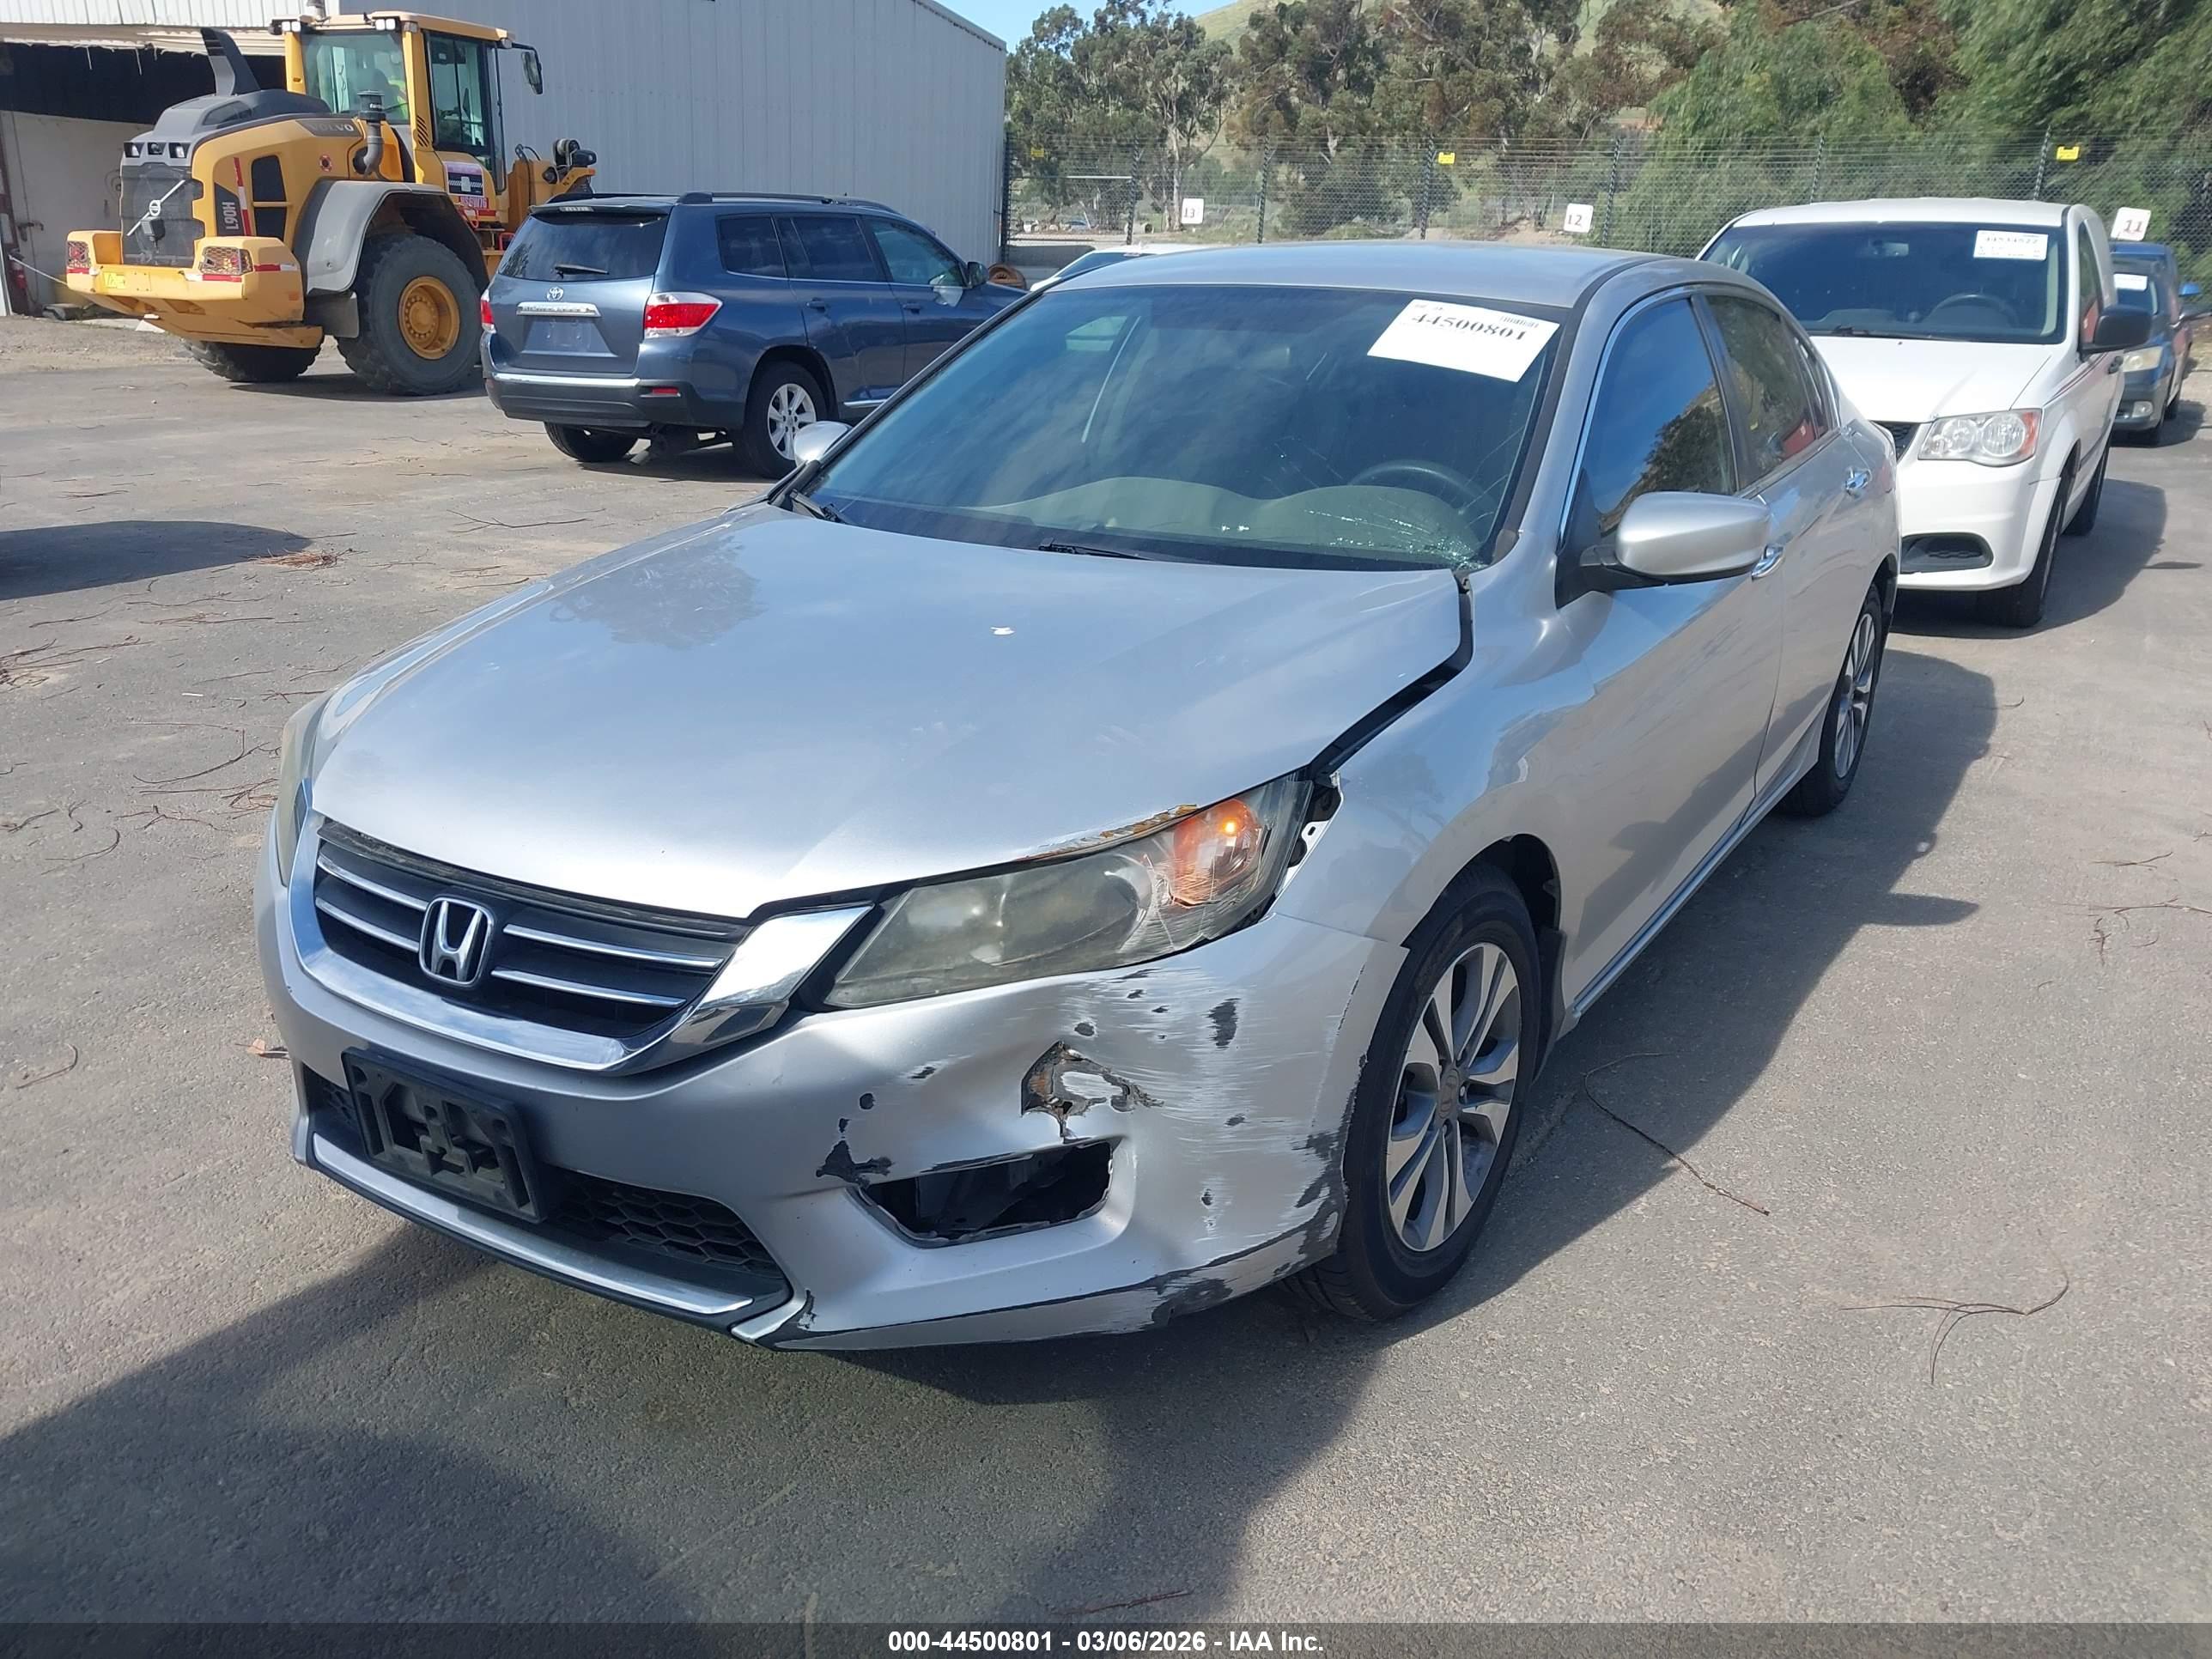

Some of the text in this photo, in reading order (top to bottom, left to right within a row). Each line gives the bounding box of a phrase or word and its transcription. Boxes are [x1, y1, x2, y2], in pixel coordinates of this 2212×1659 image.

[308, 123, 355, 131] VOLVO
[222, 201, 240, 230] L90H
[1183, 207, 1195, 218] 13
[1568, 214, 1582, 226] 12
[2123, 219, 2143, 232] 11
[1412, 313, 1527, 341] 44500801
